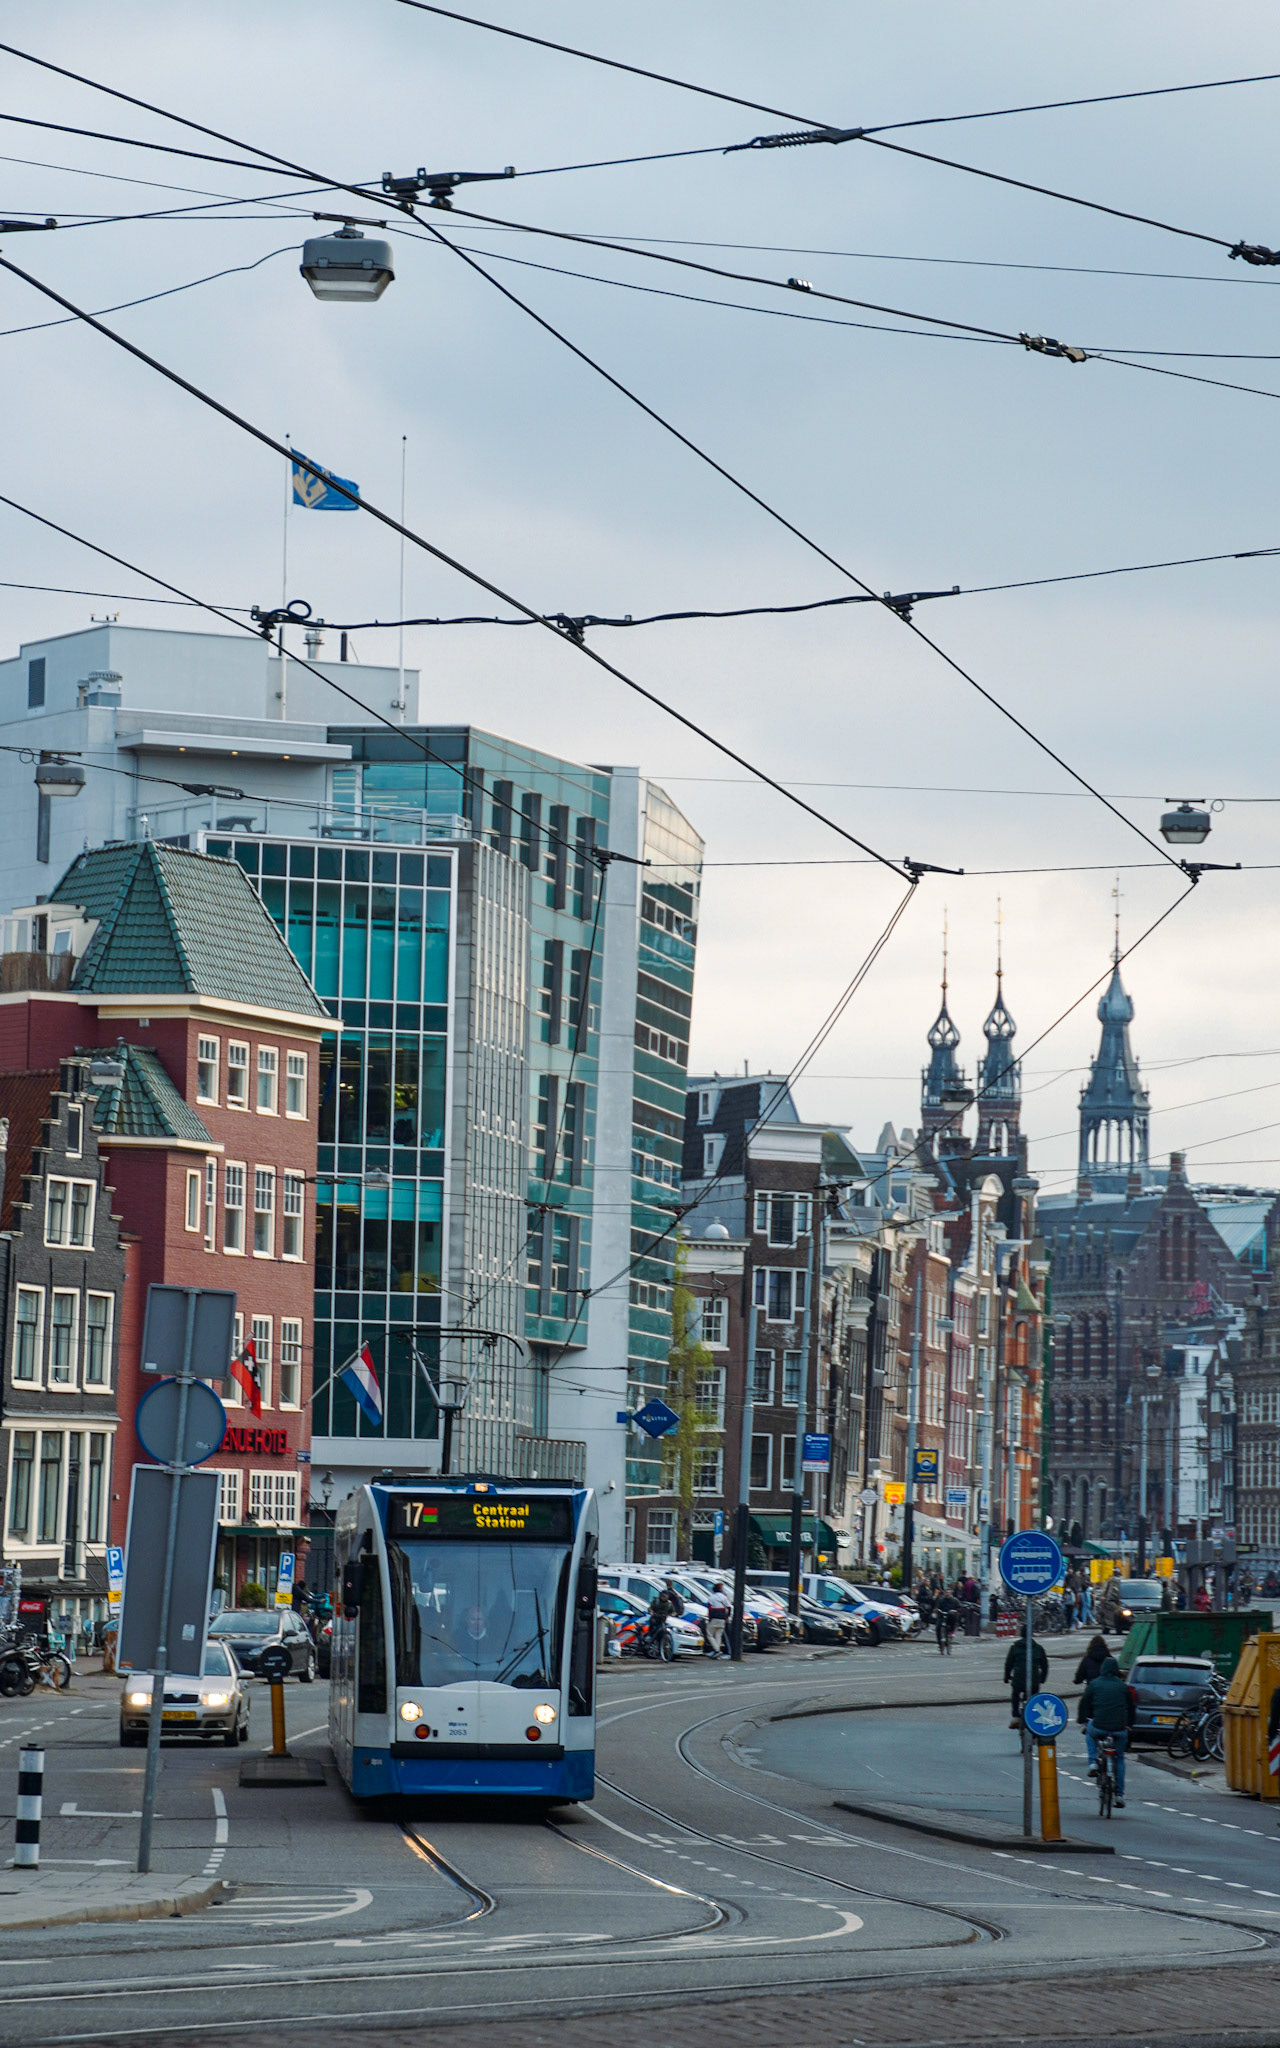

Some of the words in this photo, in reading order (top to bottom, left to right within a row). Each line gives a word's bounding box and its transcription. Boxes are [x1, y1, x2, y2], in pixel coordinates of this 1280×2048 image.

[254, 1429, 293, 1454] HOTEL
[403, 1502, 424, 1527] 17
[472, 1503, 530, 1516] Centraal
[475, 1516, 525, 1529] Station
[109, 1550, 120, 1567] P
[282, 1555, 292, 1571] P
